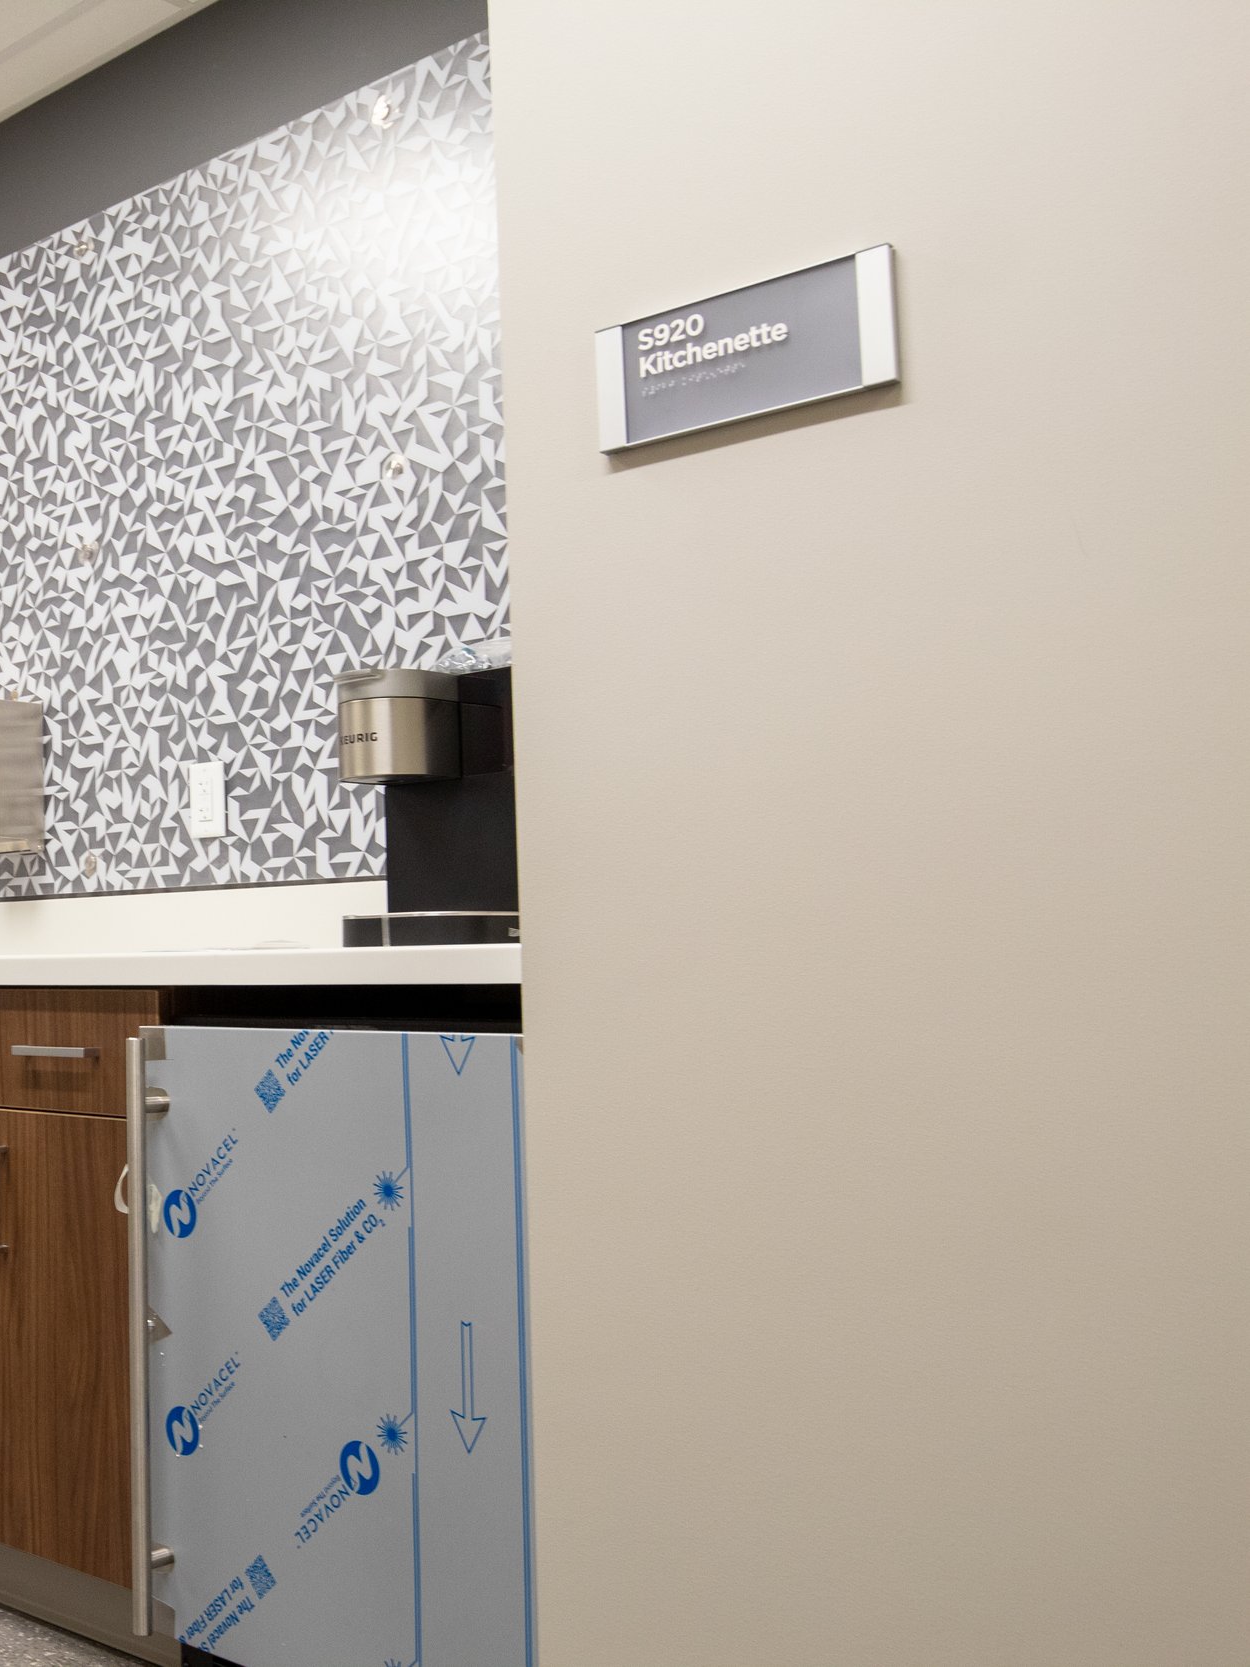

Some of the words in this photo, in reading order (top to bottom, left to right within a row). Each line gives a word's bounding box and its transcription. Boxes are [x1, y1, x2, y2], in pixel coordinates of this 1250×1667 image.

[638, 313, 704, 351] S920
[639, 322, 789, 378] Kitchenette
[275, 1047, 295, 1069] The
[286, 1067, 302, 1086] for
[298, 1031, 330, 1070] LASER
[188, 1134, 239, 1197] NOVACEL
[280, 1277, 300, 1298] The
[296, 1235, 332, 1281] Novacel
[328, 1198, 367, 1243] Solution
[291, 1298, 307, 1317] for
[304, 1264, 336, 1302] LASER
[331, 1240, 357, 1270] Fiber
[354, 1230, 366, 1244] &
[190, 1356, 241, 1416] NOVACEL
[294, 1483, 351, 1544] NOVACEL
[185, 1614, 207, 1639] Fiber
[203, 1588, 232, 1621] LASER
[207, 1610, 240, 1650] Novacel
[236, 1596, 255, 1615] The
